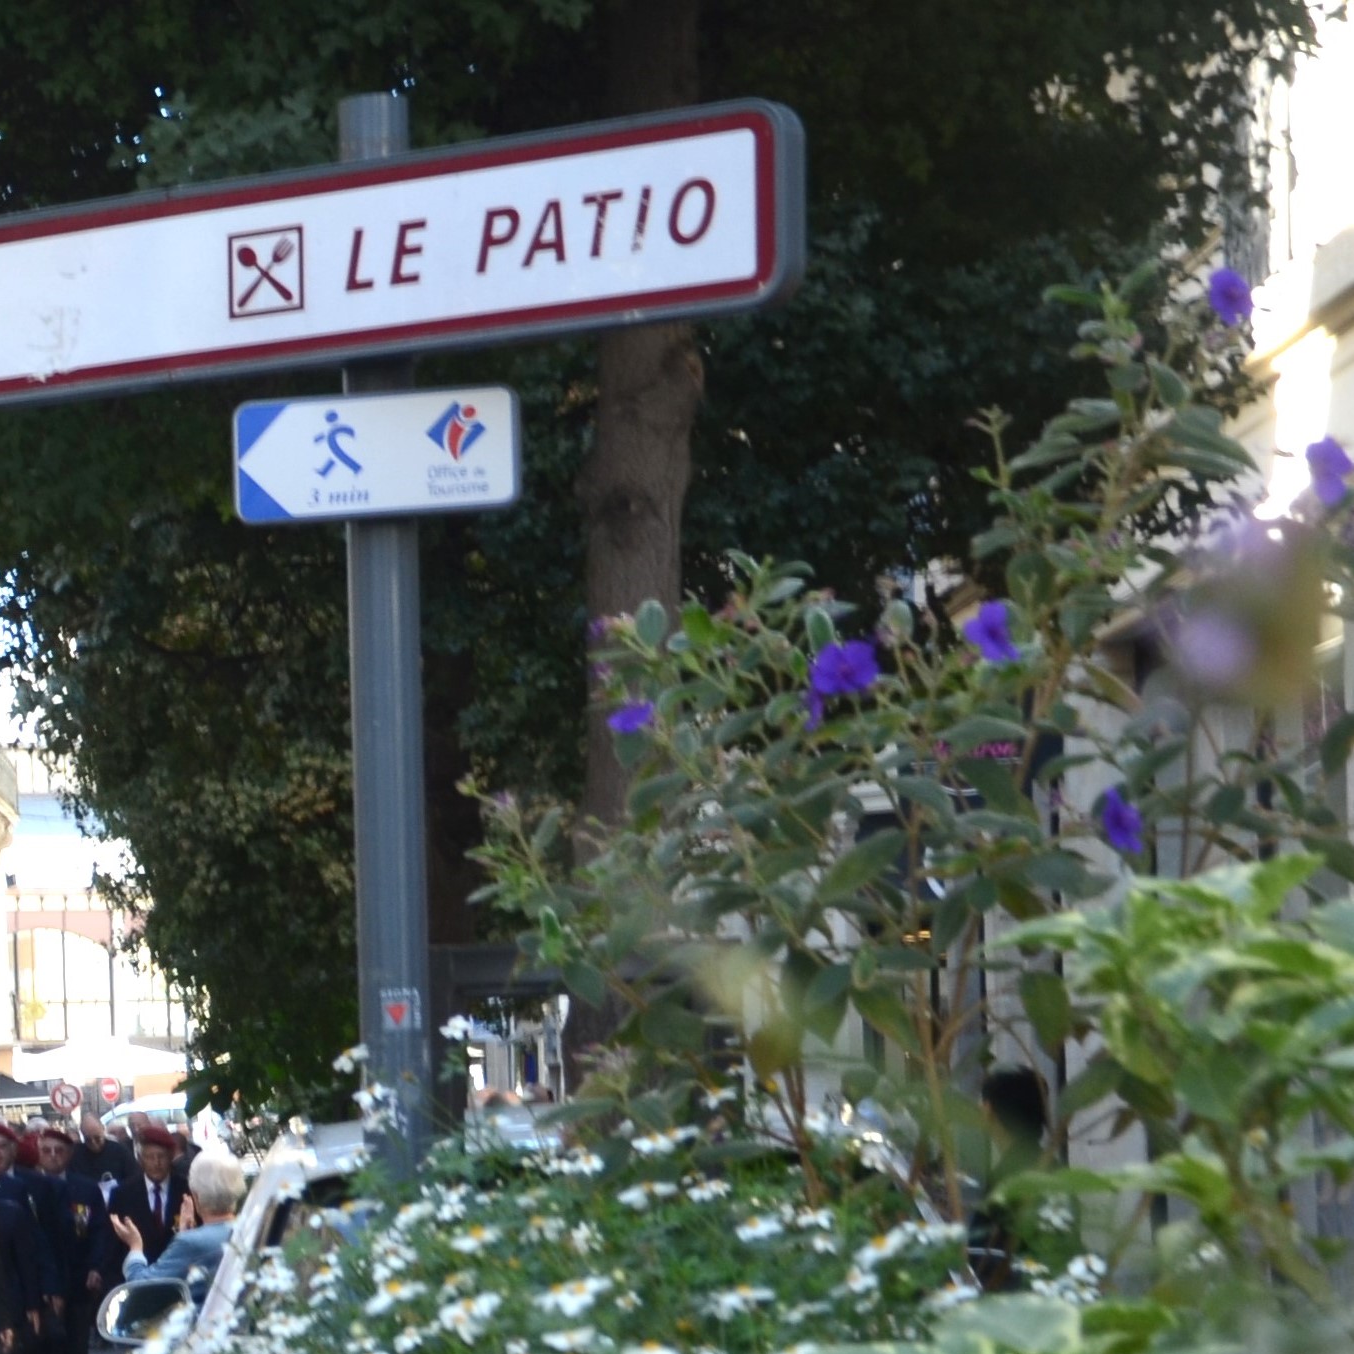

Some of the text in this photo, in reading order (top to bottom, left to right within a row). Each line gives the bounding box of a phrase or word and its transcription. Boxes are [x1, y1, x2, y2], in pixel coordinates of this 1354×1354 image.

[345, 177, 716, 291] LE PATIO
[427, 464, 468, 481] Office
[328, 486, 370, 504] min
[427, 481, 490, 497] Tourisme
